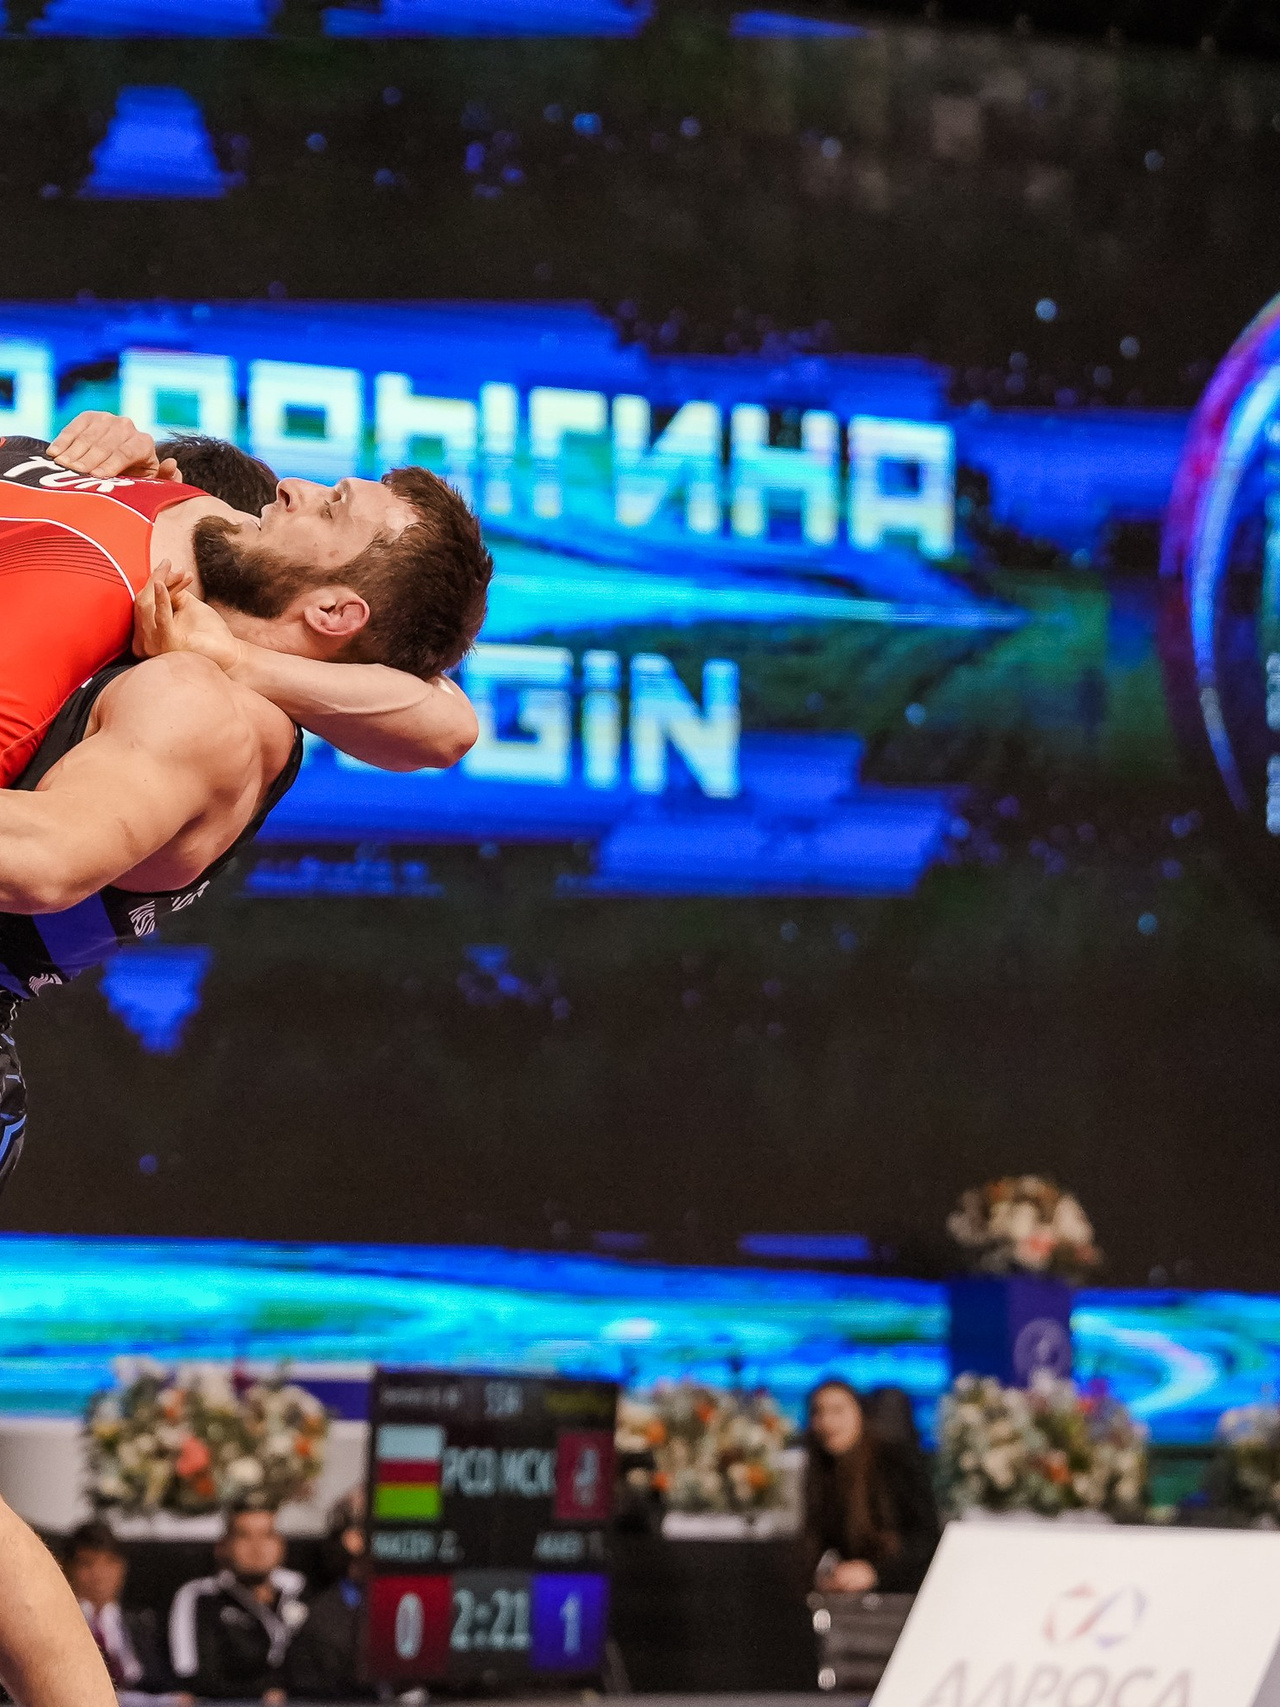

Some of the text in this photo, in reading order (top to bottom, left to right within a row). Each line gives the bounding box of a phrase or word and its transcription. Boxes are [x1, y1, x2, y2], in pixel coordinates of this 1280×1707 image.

[3, 455, 136, 493] TUR
[395, 1589, 582, 1659] 0 2:21 1
